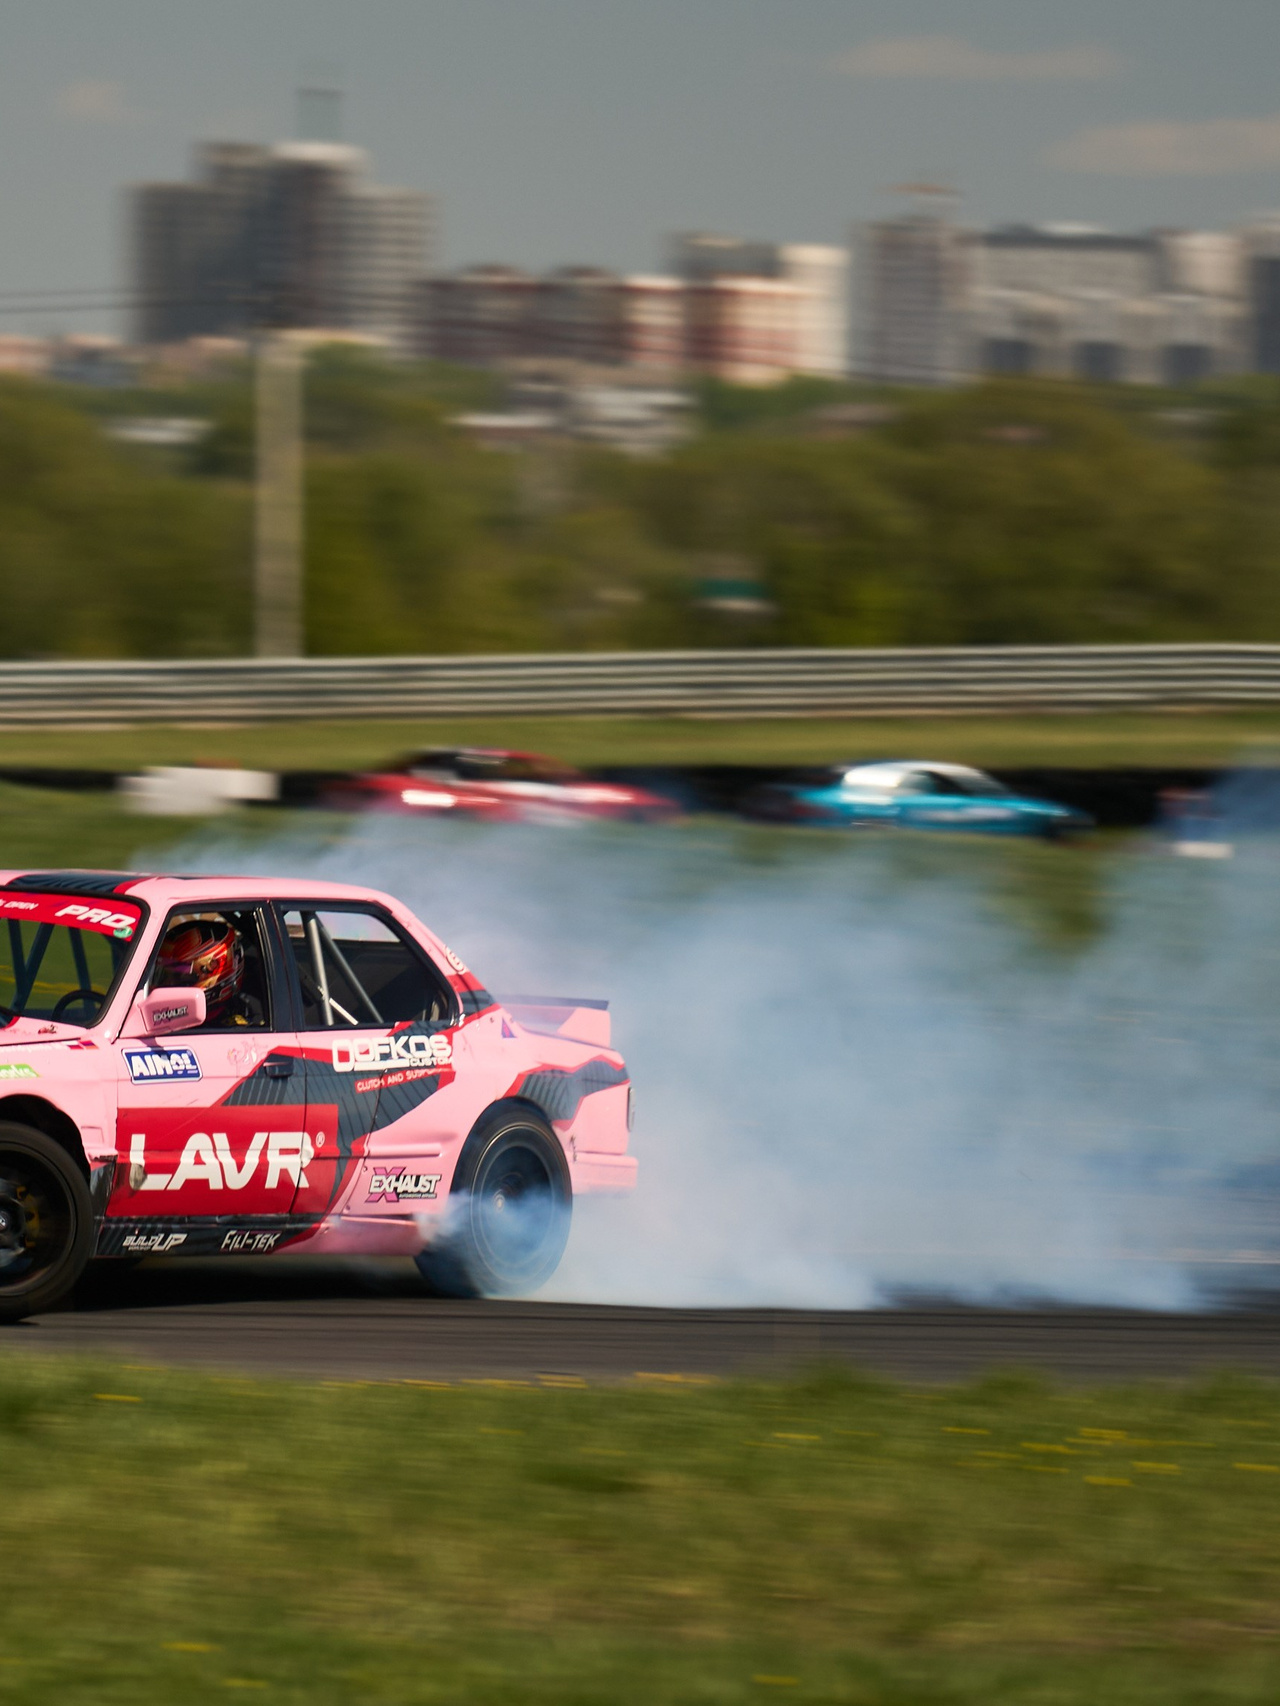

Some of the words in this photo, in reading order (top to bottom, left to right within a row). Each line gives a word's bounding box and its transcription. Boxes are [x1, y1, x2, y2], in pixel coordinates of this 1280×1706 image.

[54, 904, 136, 928] PRO
[153, 1006, 188, 1022] EXHAUST
[357, 1078, 385, 1091] CLUTCH
[387, 1073, 404, 1084] AND
[129, 1131, 315, 1191] LAVR
[369, 1174, 441, 1193] EXHAUST
[221, 1230, 281, 1252] FILI-TEK
